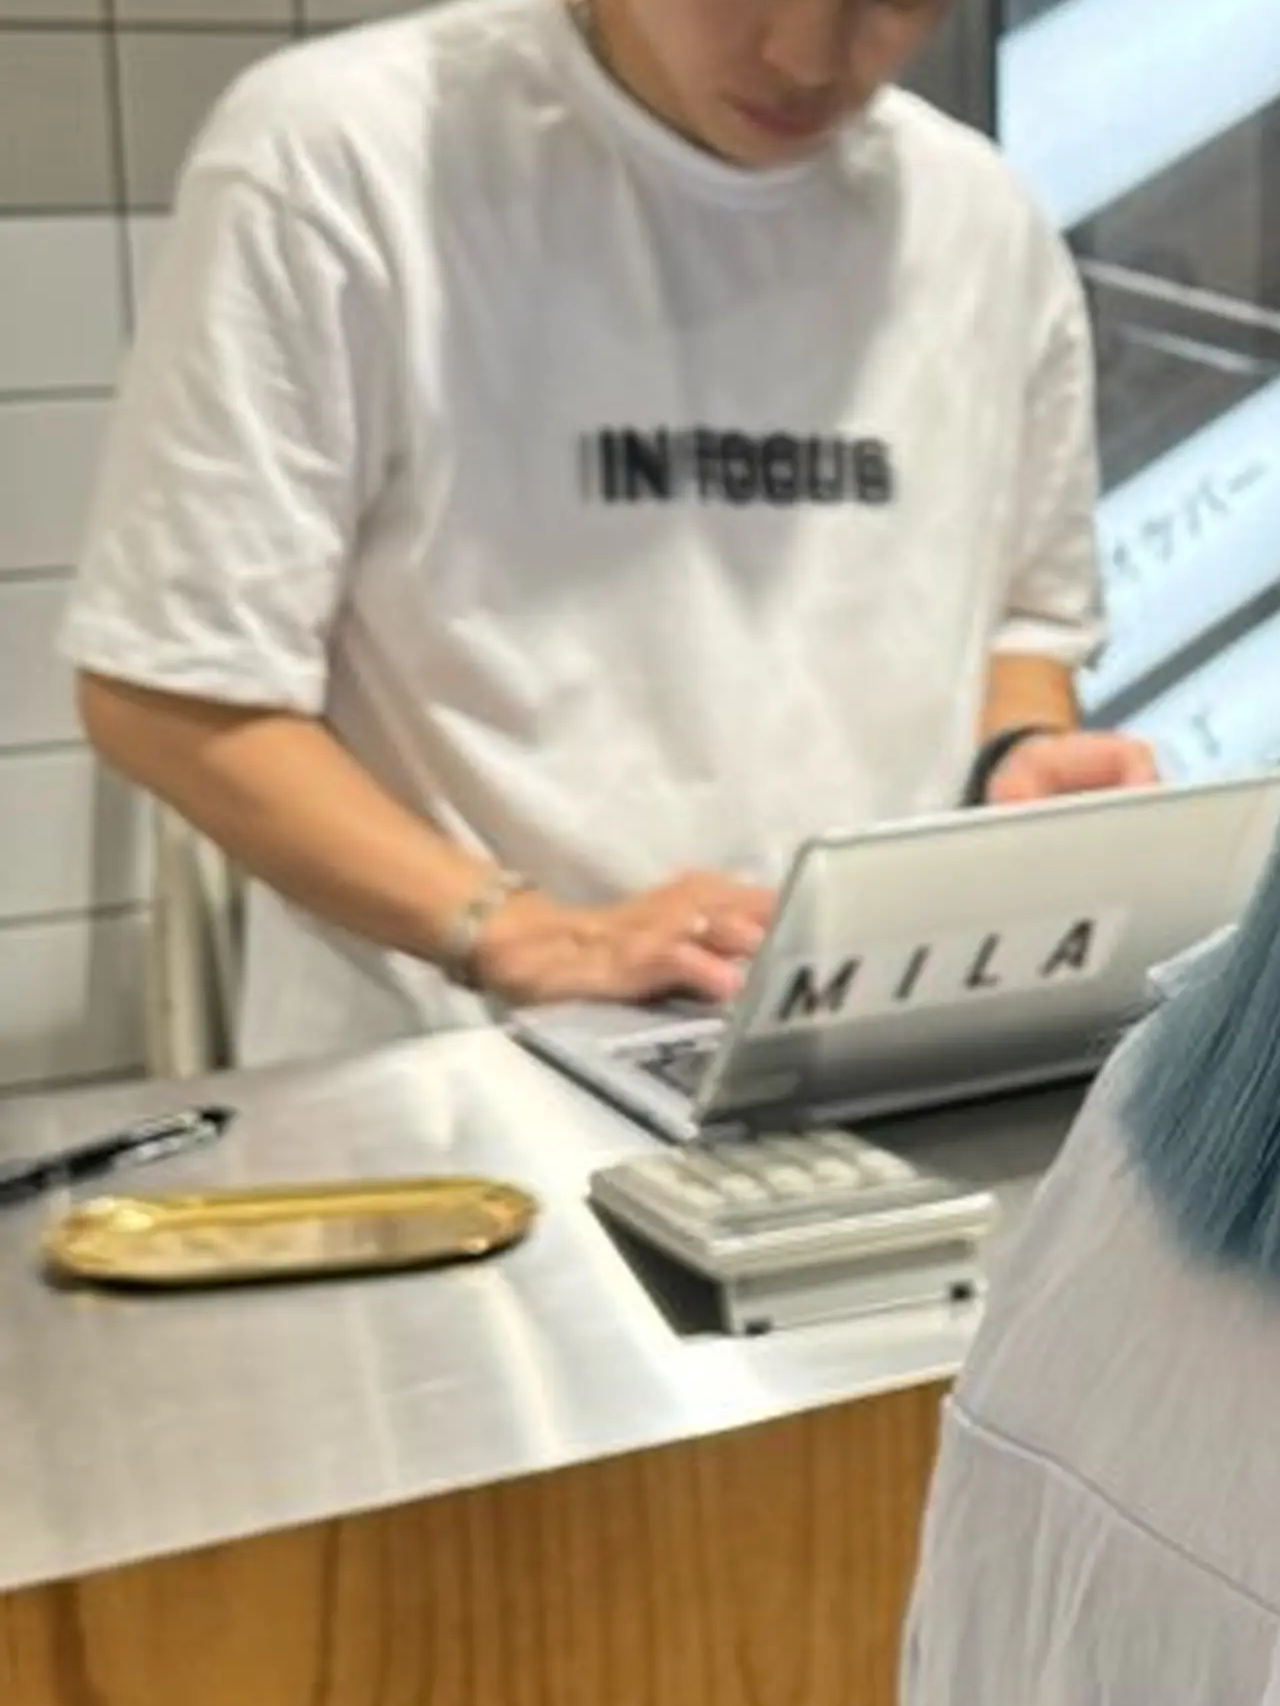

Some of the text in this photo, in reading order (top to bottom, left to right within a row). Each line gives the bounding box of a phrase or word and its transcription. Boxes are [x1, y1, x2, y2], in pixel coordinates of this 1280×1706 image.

[584, 425, 894, 507] IN FOCUS
[774, 916, 1096, 1024] MILA
